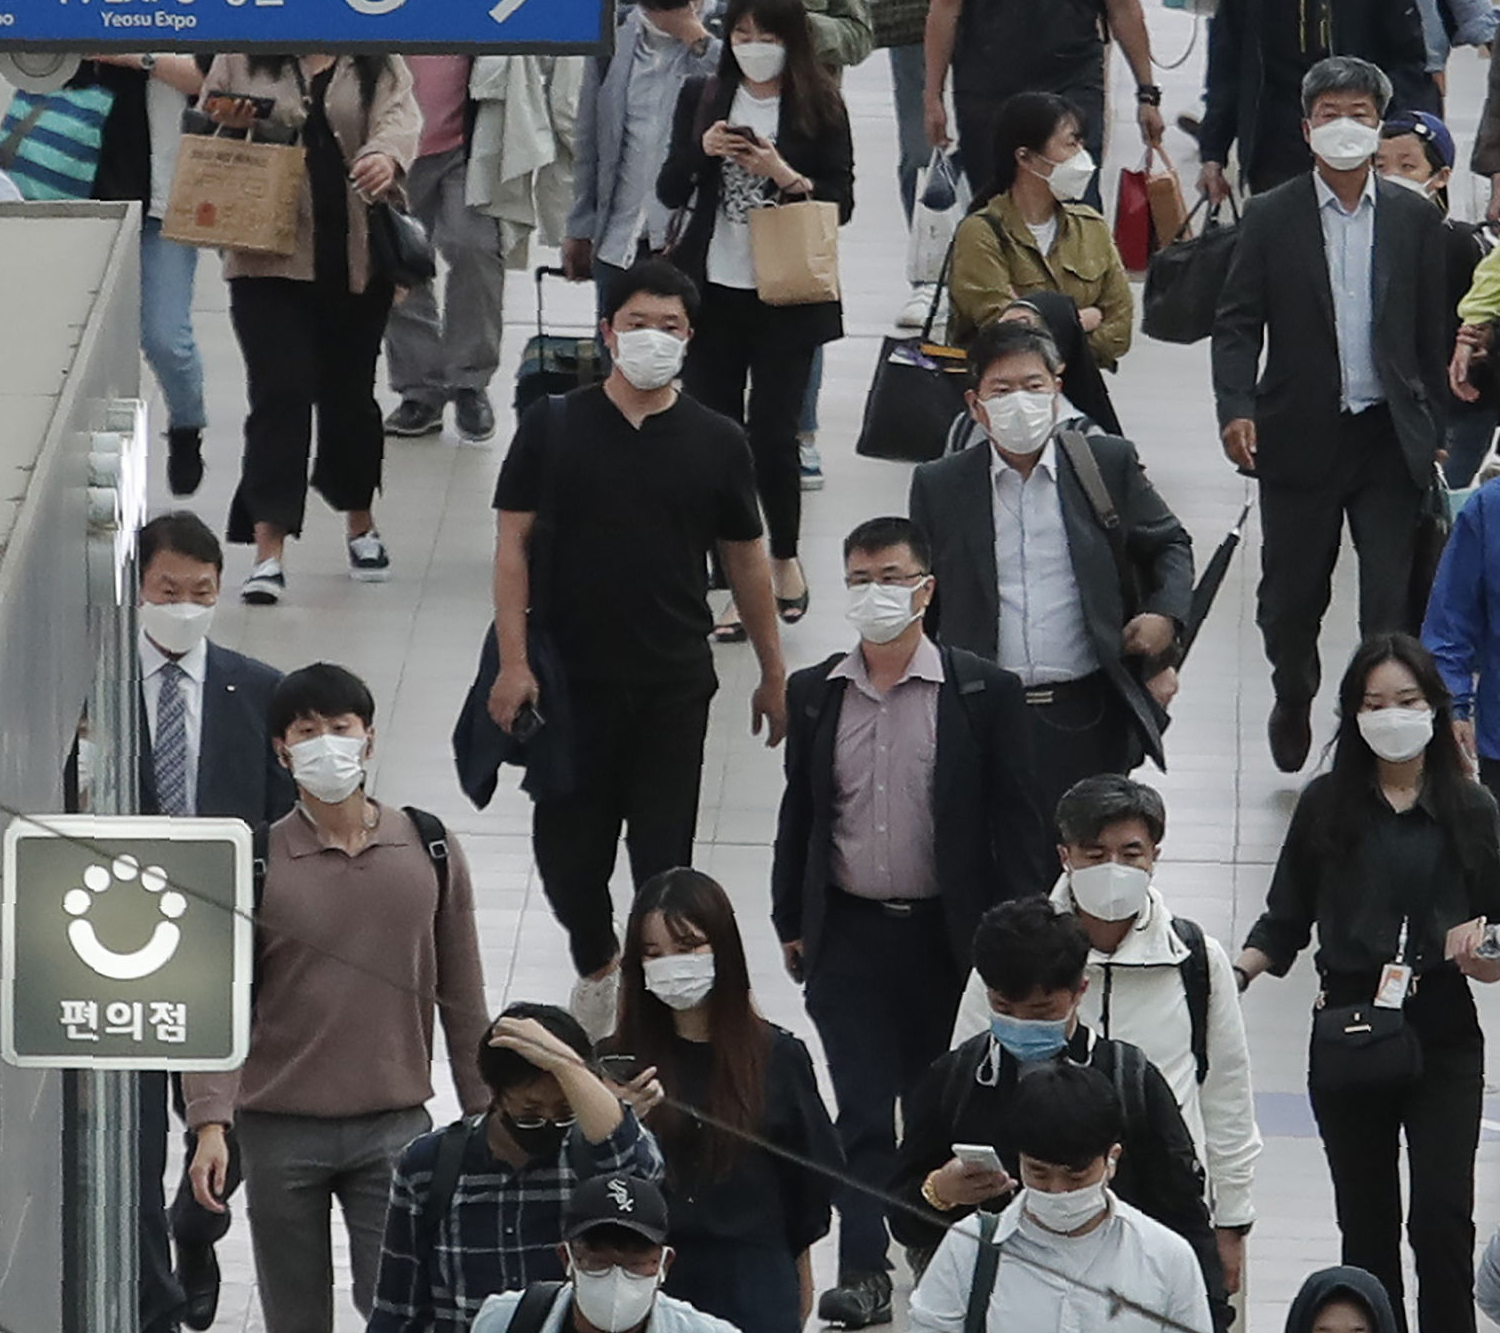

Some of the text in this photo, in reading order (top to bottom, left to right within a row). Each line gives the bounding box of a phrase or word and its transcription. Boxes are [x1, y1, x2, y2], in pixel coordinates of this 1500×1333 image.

[101, 10, 149, 28] Yeosu
[155, 10, 197, 31] Expo
[60, 999, 187, 1043] 편의점
